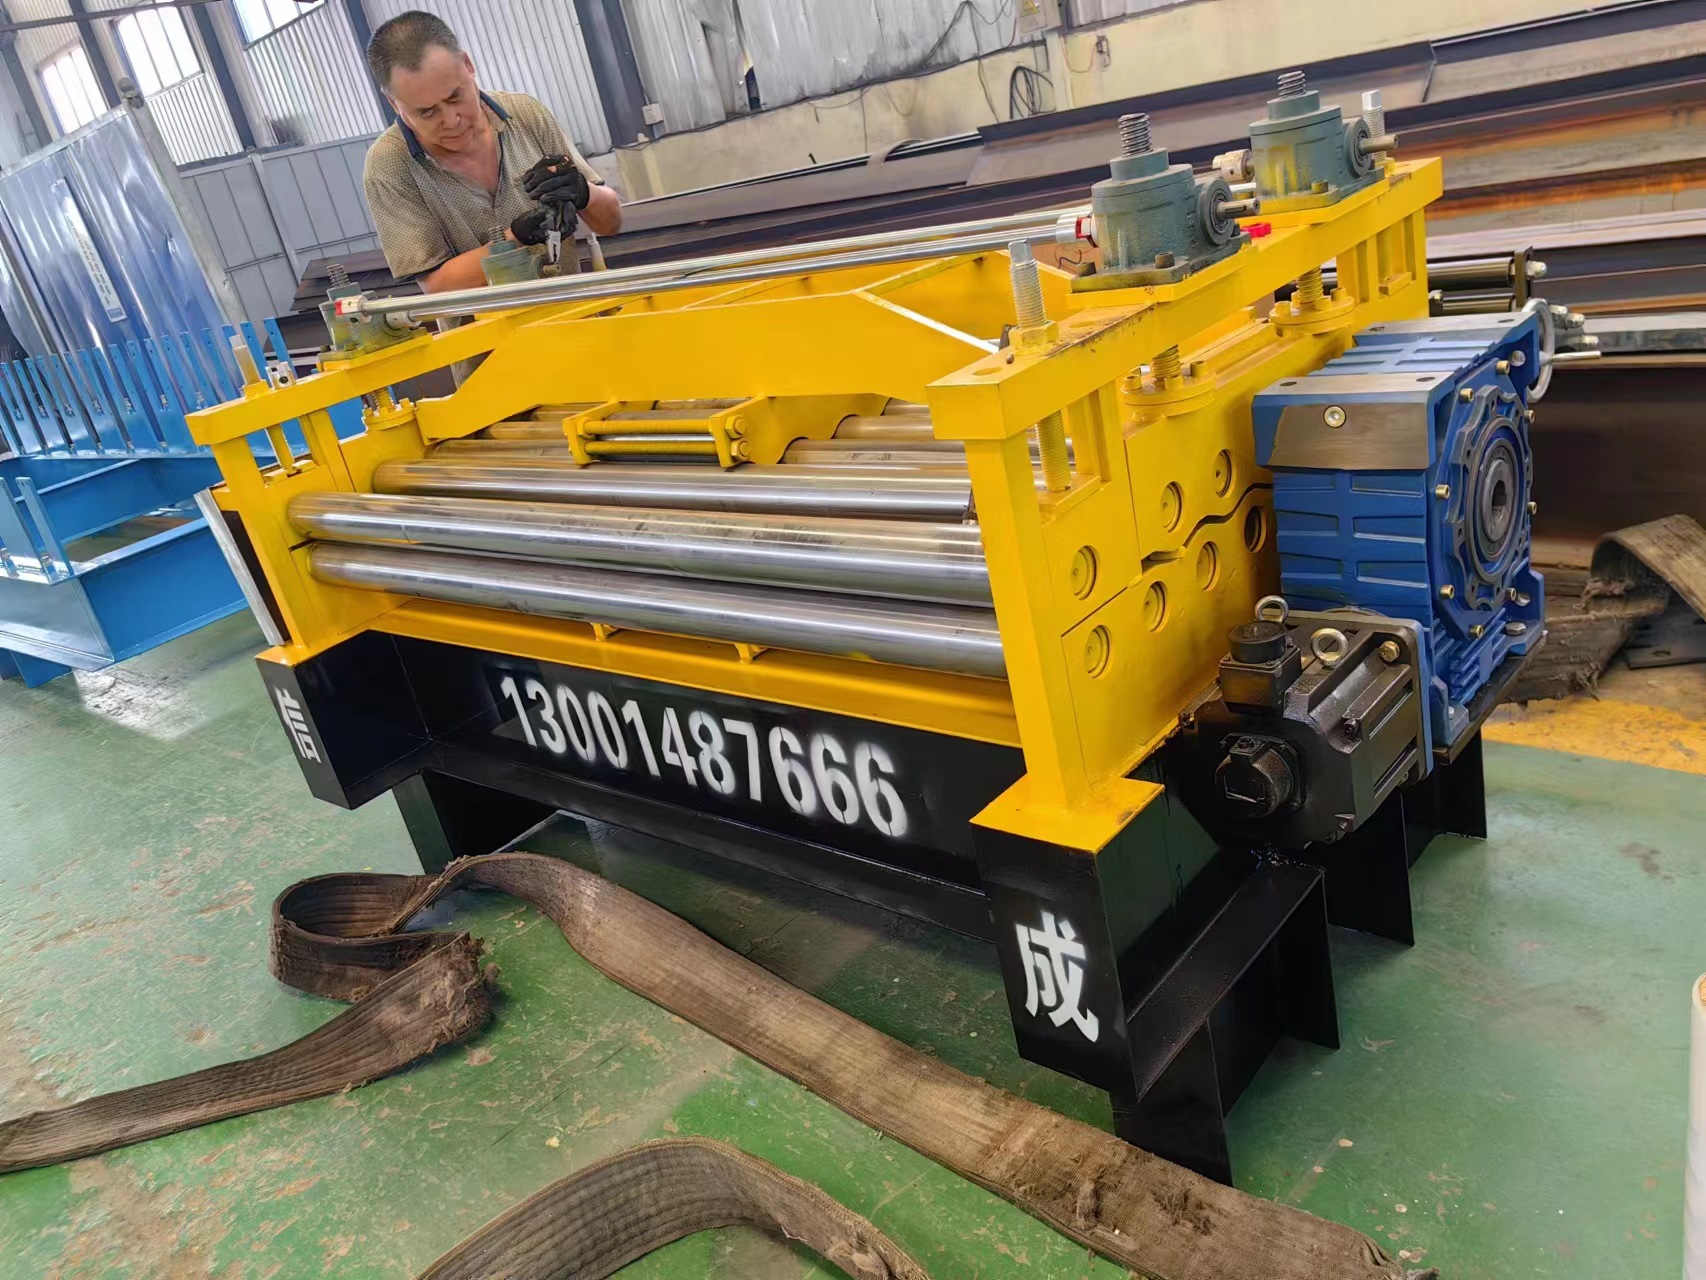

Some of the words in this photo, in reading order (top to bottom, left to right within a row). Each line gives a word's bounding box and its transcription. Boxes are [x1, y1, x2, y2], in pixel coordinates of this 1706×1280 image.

[274, 686, 322, 763] 信
[500, 676, 908, 837] 13001487666
[1015, 910, 1099, 1043] 成
